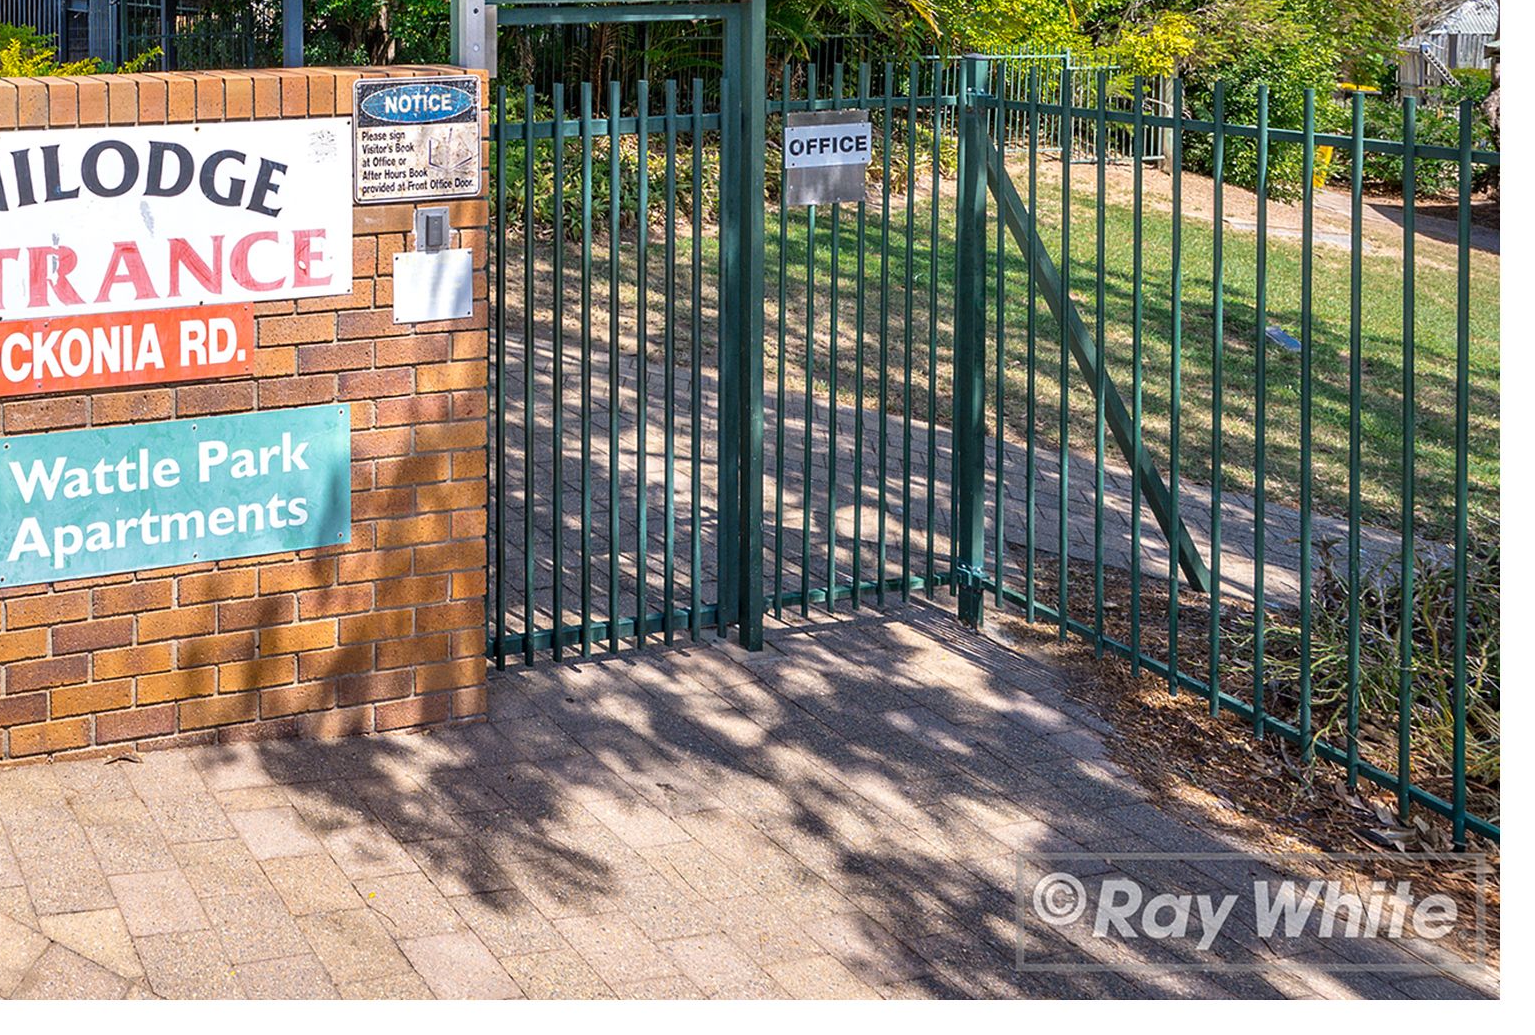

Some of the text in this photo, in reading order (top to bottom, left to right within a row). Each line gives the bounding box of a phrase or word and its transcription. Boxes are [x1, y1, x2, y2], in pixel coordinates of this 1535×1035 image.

[385, 94, 452, 114] NOTICE
[361, 130, 405, 142] Please sign
[789, 135, 867, 156] OFFICE
[362, 142, 415, 154] Visitor's Book
[362, 158, 370, 167] at
[372, 156, 396, 167] Office
[362, 168, 428, 181] After Hours Book
[362, 182, 395, 196] provided
[397, 182, 405, 191] at
[408, 181, 428, 191] Front
[430, 178, 452, 189] Office
[179, 316, 247, 367] RD.
[8, 431, 311, 505] Wattle Park
[7, 491, 309, 569] Apartments
